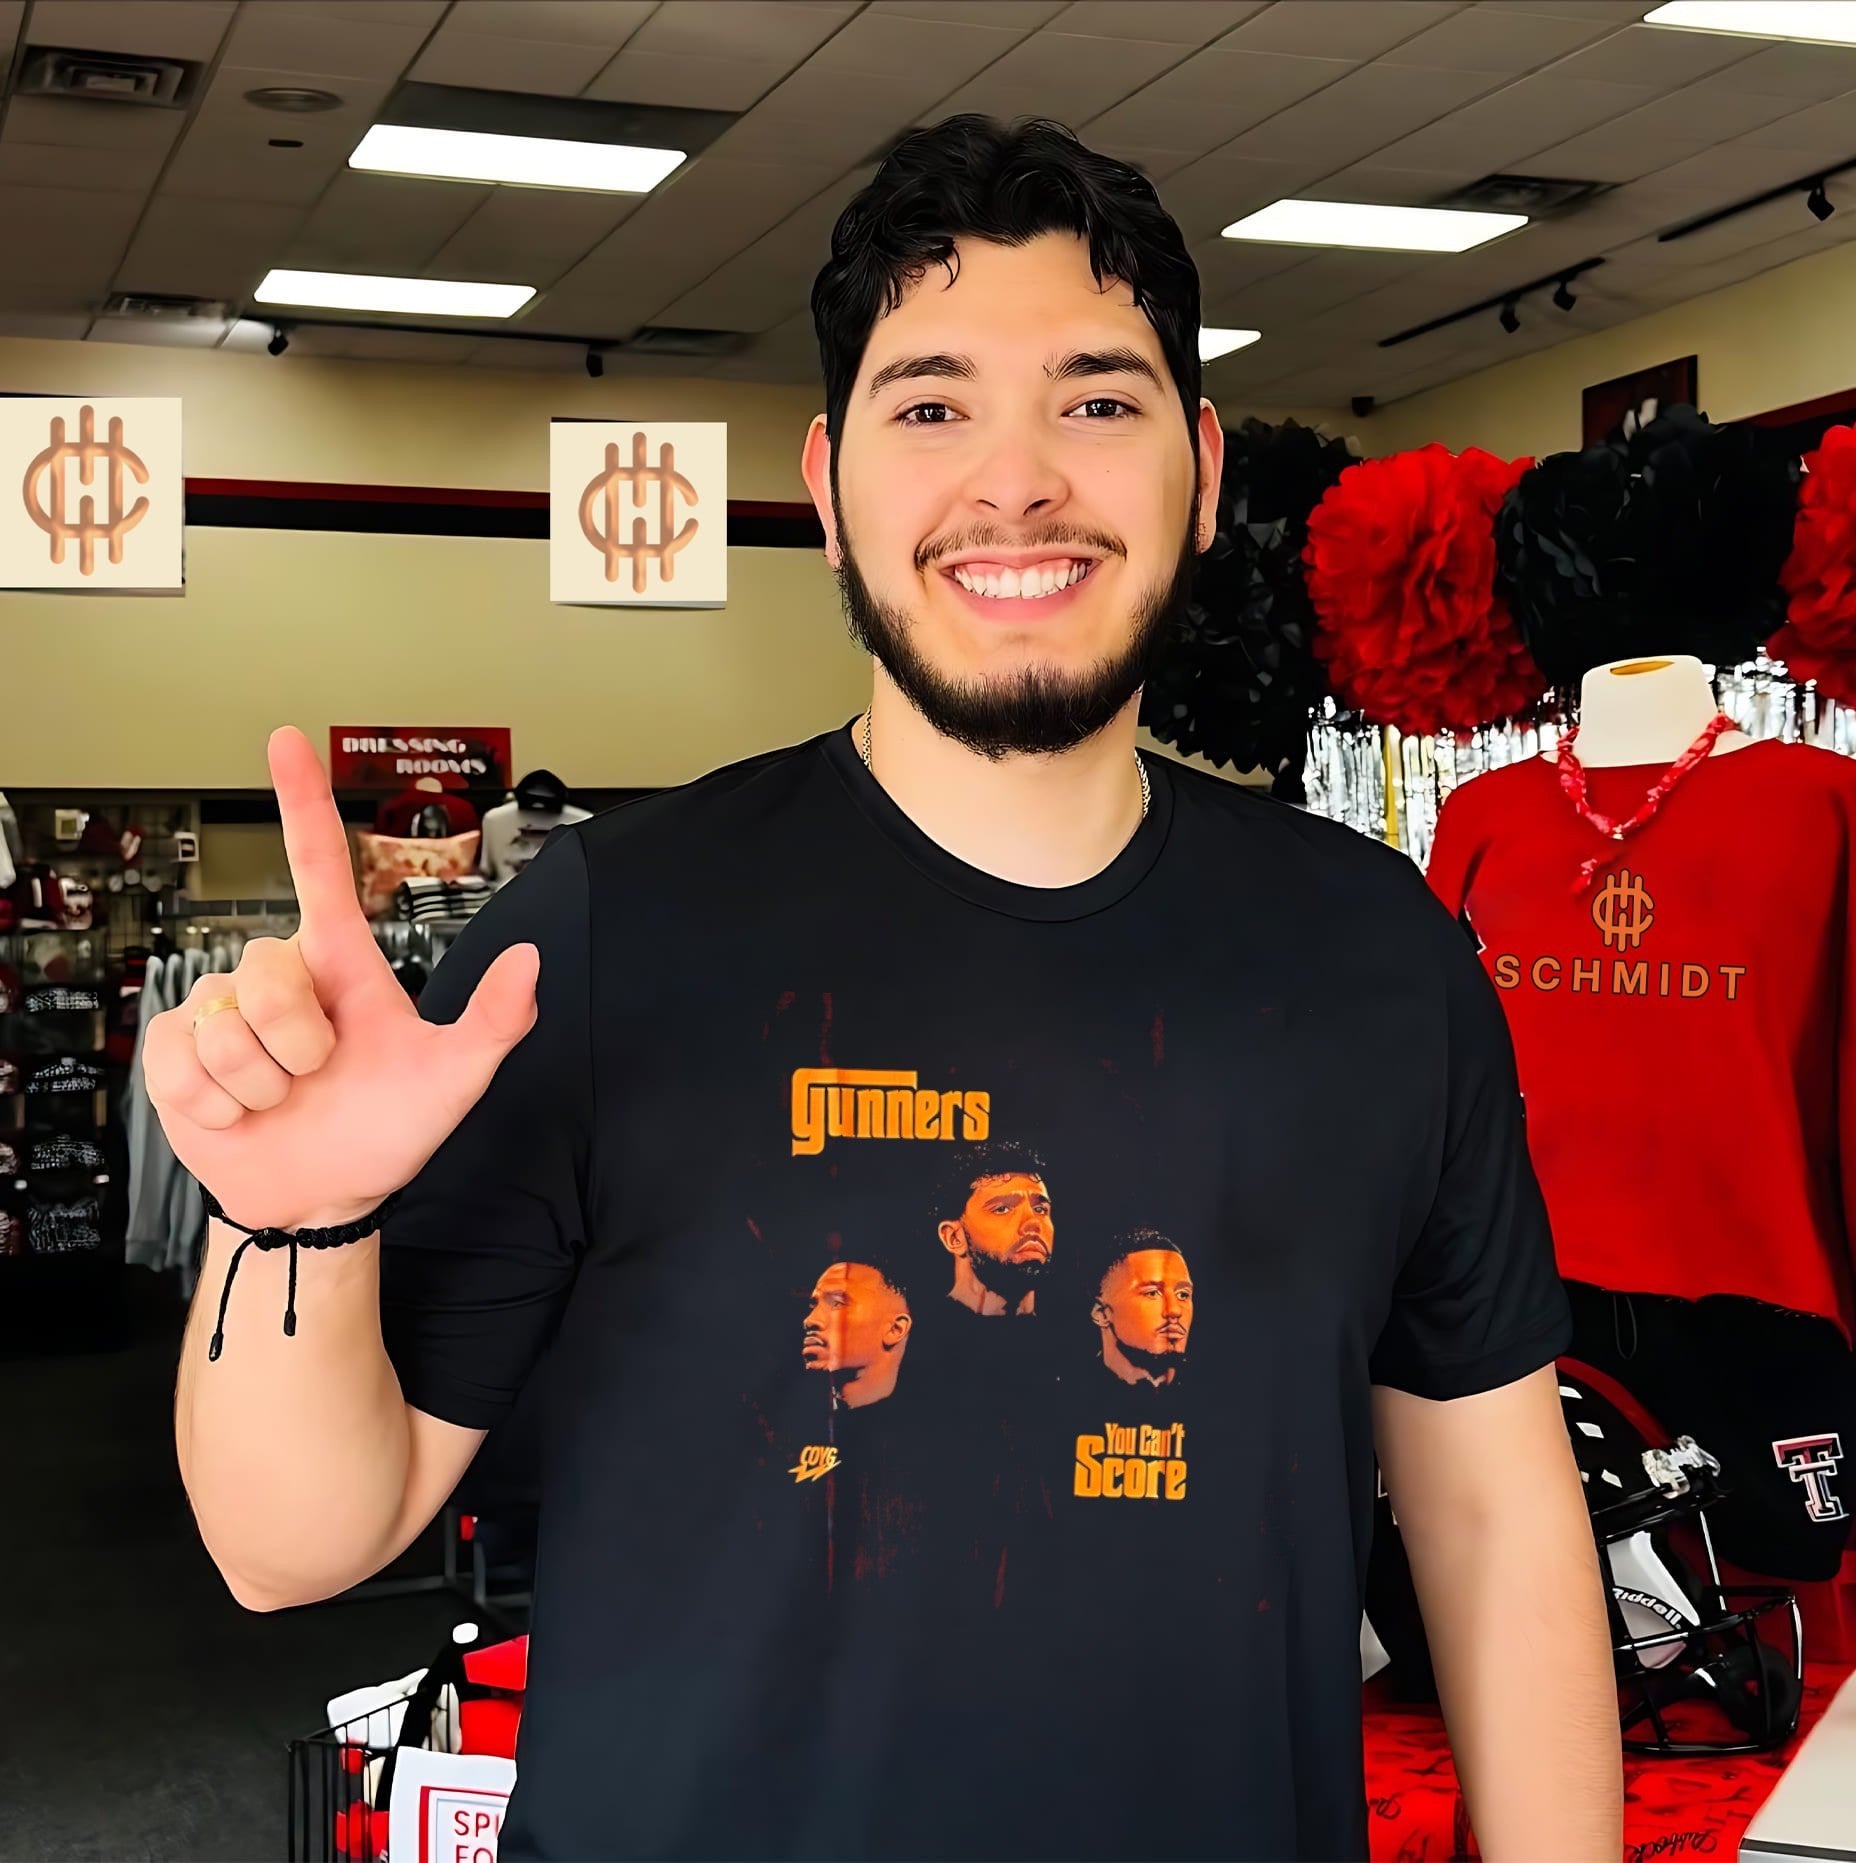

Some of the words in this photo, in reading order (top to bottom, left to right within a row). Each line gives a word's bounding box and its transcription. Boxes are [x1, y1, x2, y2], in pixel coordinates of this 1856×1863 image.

[342, 737, 466, 753] DRESSING
[396, 759, 486, 774] ROOMS
[1494, 954, 1746, 1000] SCHMIDT
[1105, 1422, 1137, 1455] You
[1139, 1422, 1185, 1458] Can't
[798, 1445, 839, 1472] COYG
[1074, 1434, 1187, 1500] Score
